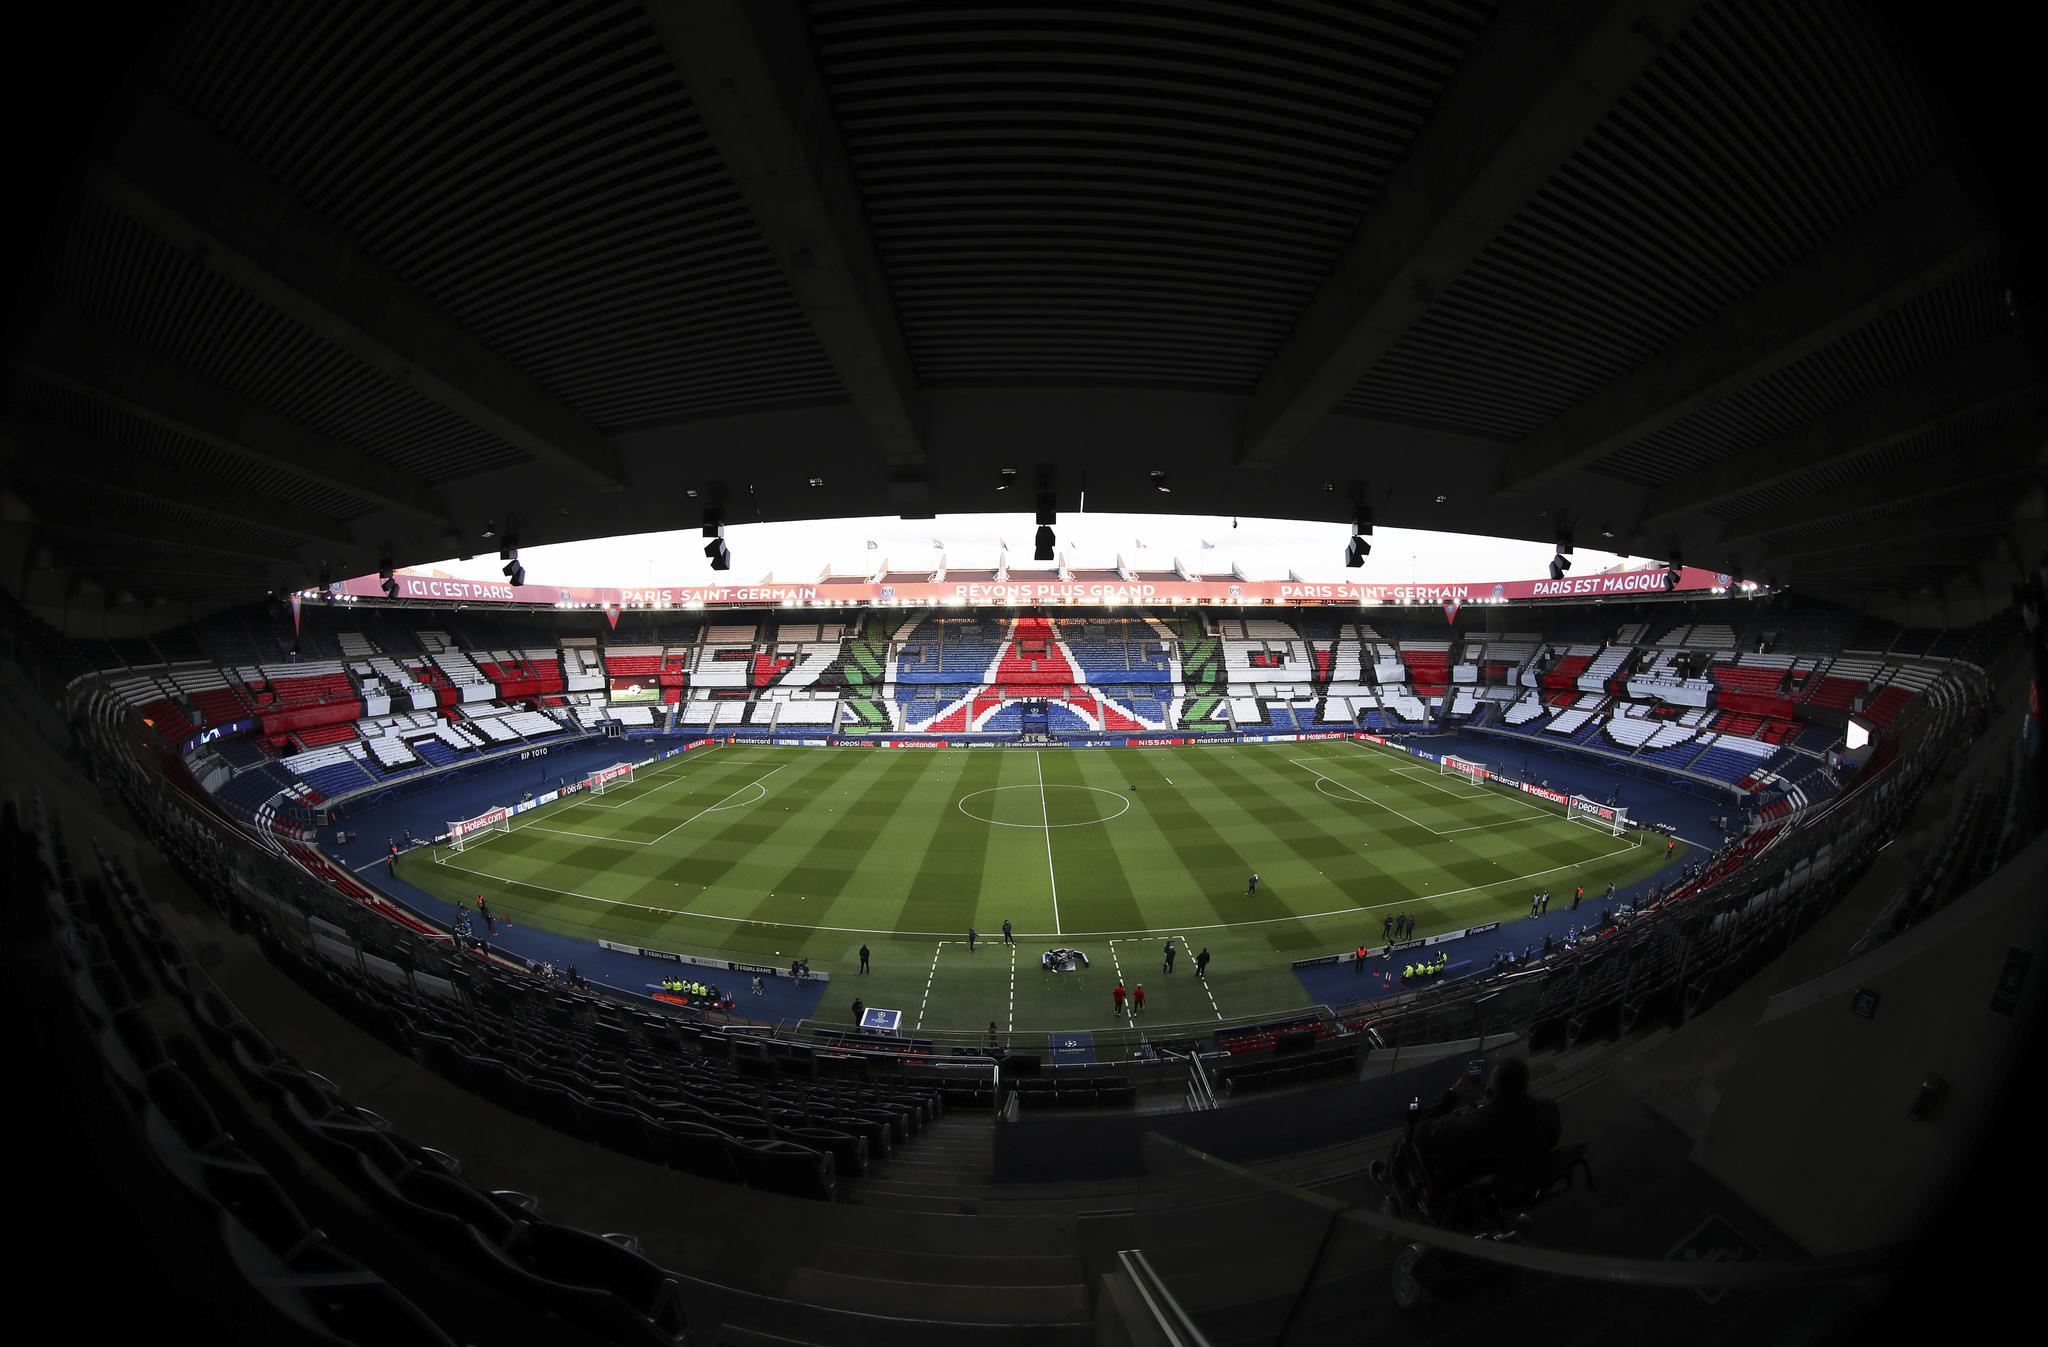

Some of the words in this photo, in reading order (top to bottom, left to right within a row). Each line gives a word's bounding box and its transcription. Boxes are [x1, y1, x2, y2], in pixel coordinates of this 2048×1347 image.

[407, 580, 428, 595] ICI
[430, 581, 470, 598] C'EST
[474, 583, 514, 600] PARIS
[1037, 585, 1085, 597] PLUS
[1090, 584, 1155, 597] GRAND
[1281, 586, 1333, 599] PARIS
[1336, 586, 1468, 600] SAINT-GERMAIN
[1533, 579, 1572, 595] PARIS
[1574, 578, 1600, 593] EST
[622, 590, 672, 601] PARIS
[681, 588, 816, 601] SAINT-GERMAIN
[1307, 732, 1341, 740] Hotels.com
[1529, 784, 1564, 804] Hotels.com
[1578, 802, 1599, 814] pepsi
[464, 812, 504, 834] Hotels.com
